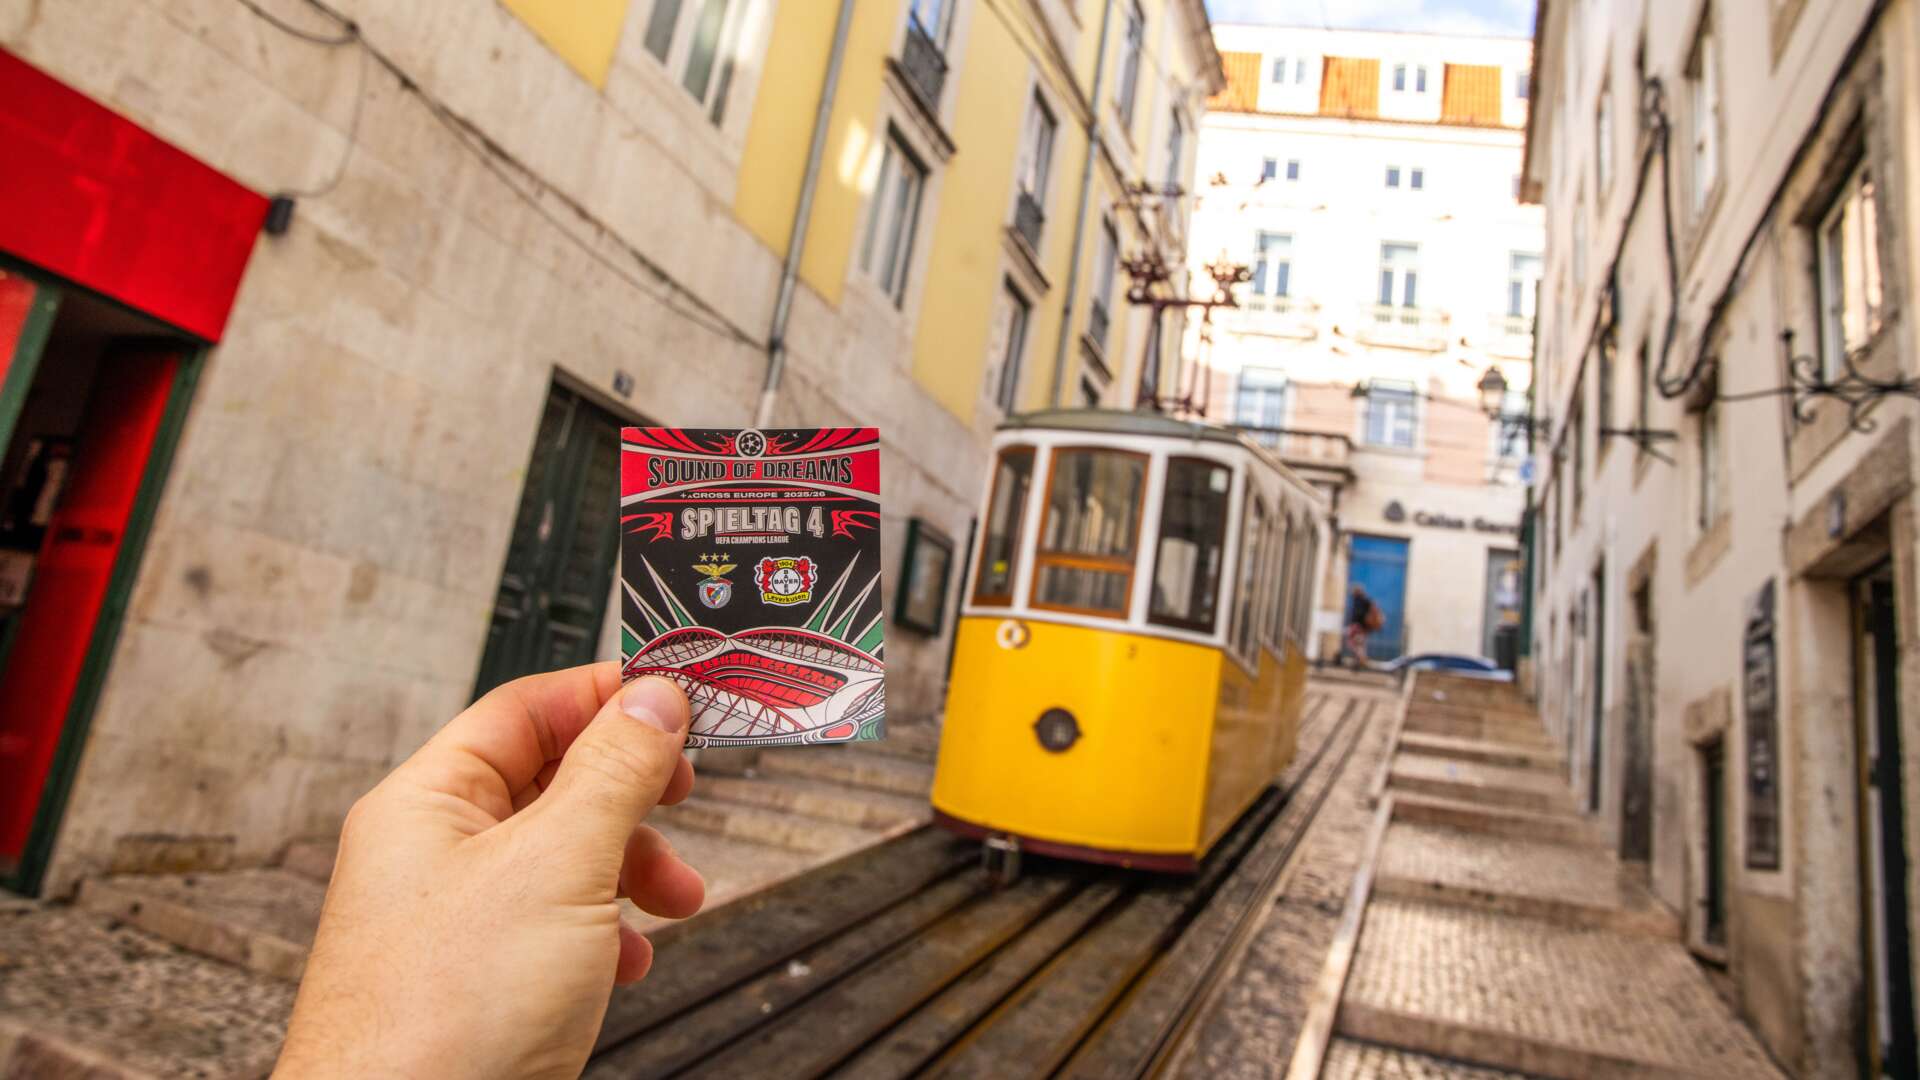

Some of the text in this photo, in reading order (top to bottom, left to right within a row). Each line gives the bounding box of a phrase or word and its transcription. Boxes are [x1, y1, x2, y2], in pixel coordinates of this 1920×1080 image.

[647, 456, 853, 488] SOUND OF DREAMS
[733, 491, 778, 499] EUROPE
[783, 490, 826, 499] 2025/26
[680, 506, 825, 541] SPIELTAG 4
[715, 535, 790, 545] UEFA CHAMPIONS LEAGUE
[779, 560, 793, 568] 1904
[766, 593, 807, 603] Leverkusen
